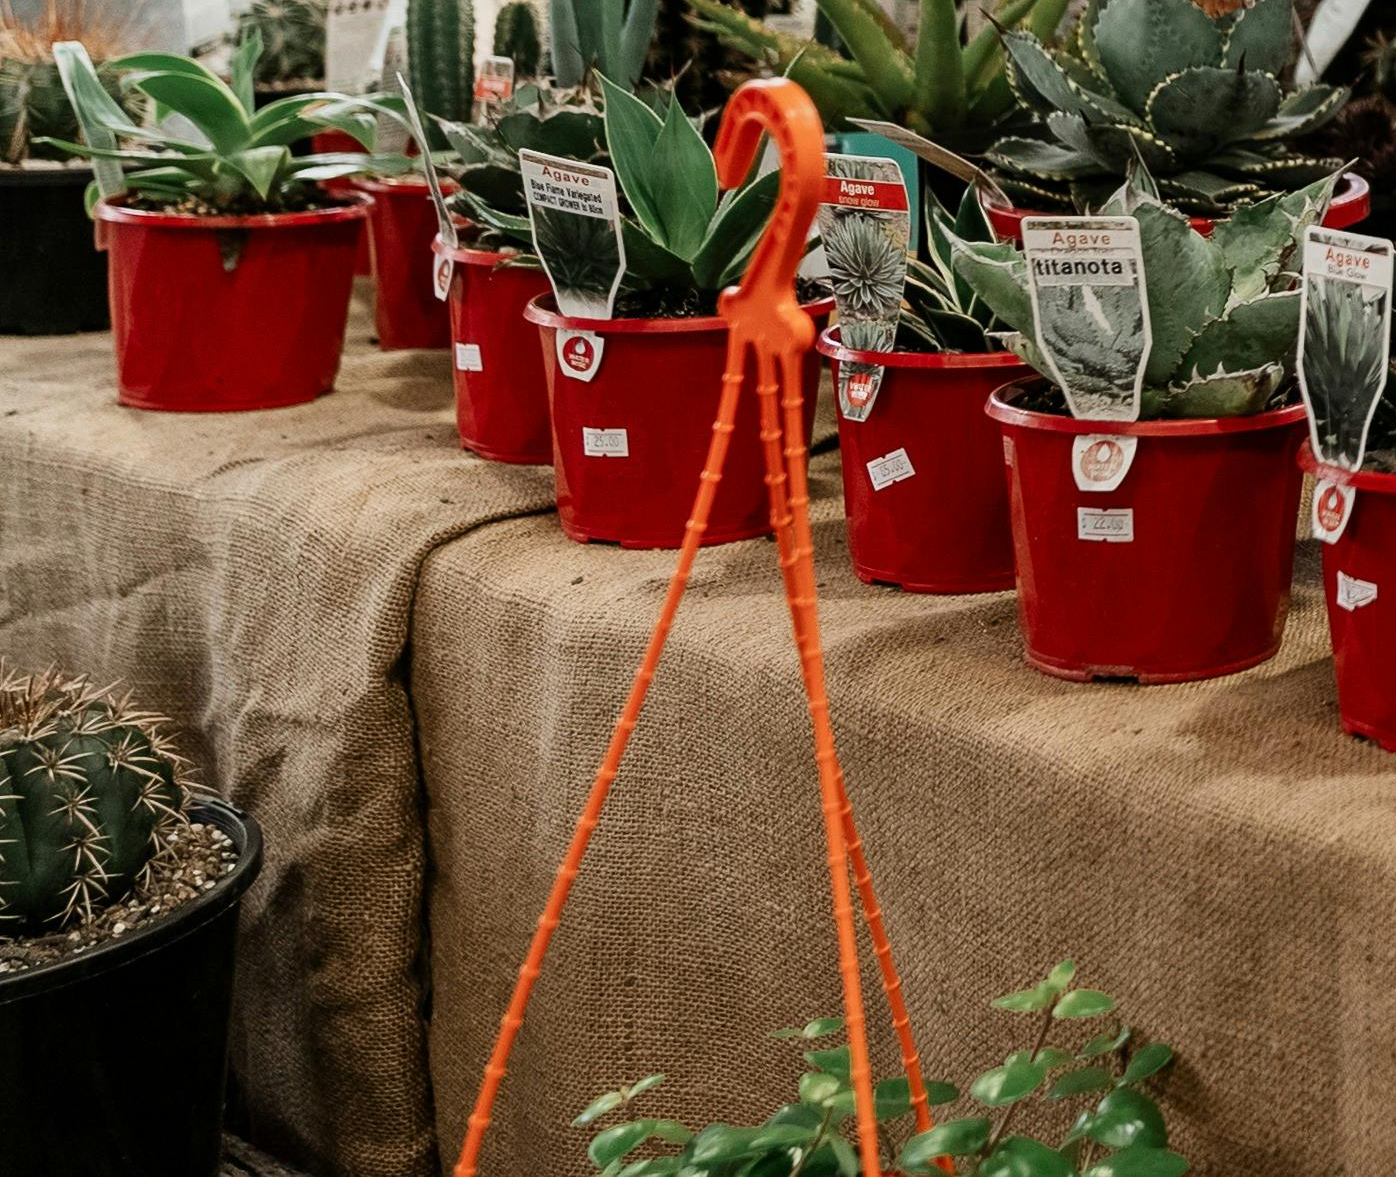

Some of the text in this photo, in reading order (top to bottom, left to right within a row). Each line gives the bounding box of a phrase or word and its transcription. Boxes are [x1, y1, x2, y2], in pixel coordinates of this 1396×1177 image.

[542, 166, 589, 186] Agave
[530, 178, 602, 204] Blue Flame Variegated
[840, 180, 875, 196] Agave
[533, 191, 558, 205] COMPACT
[559, 197, 580, 210] GROWER
[860, 197, 880, 208] glow
[1052, 231, 1111, 248] Agave
[1035, 259, 1123, 275] titanota
[1325, 247, 1370, 269] Agave
